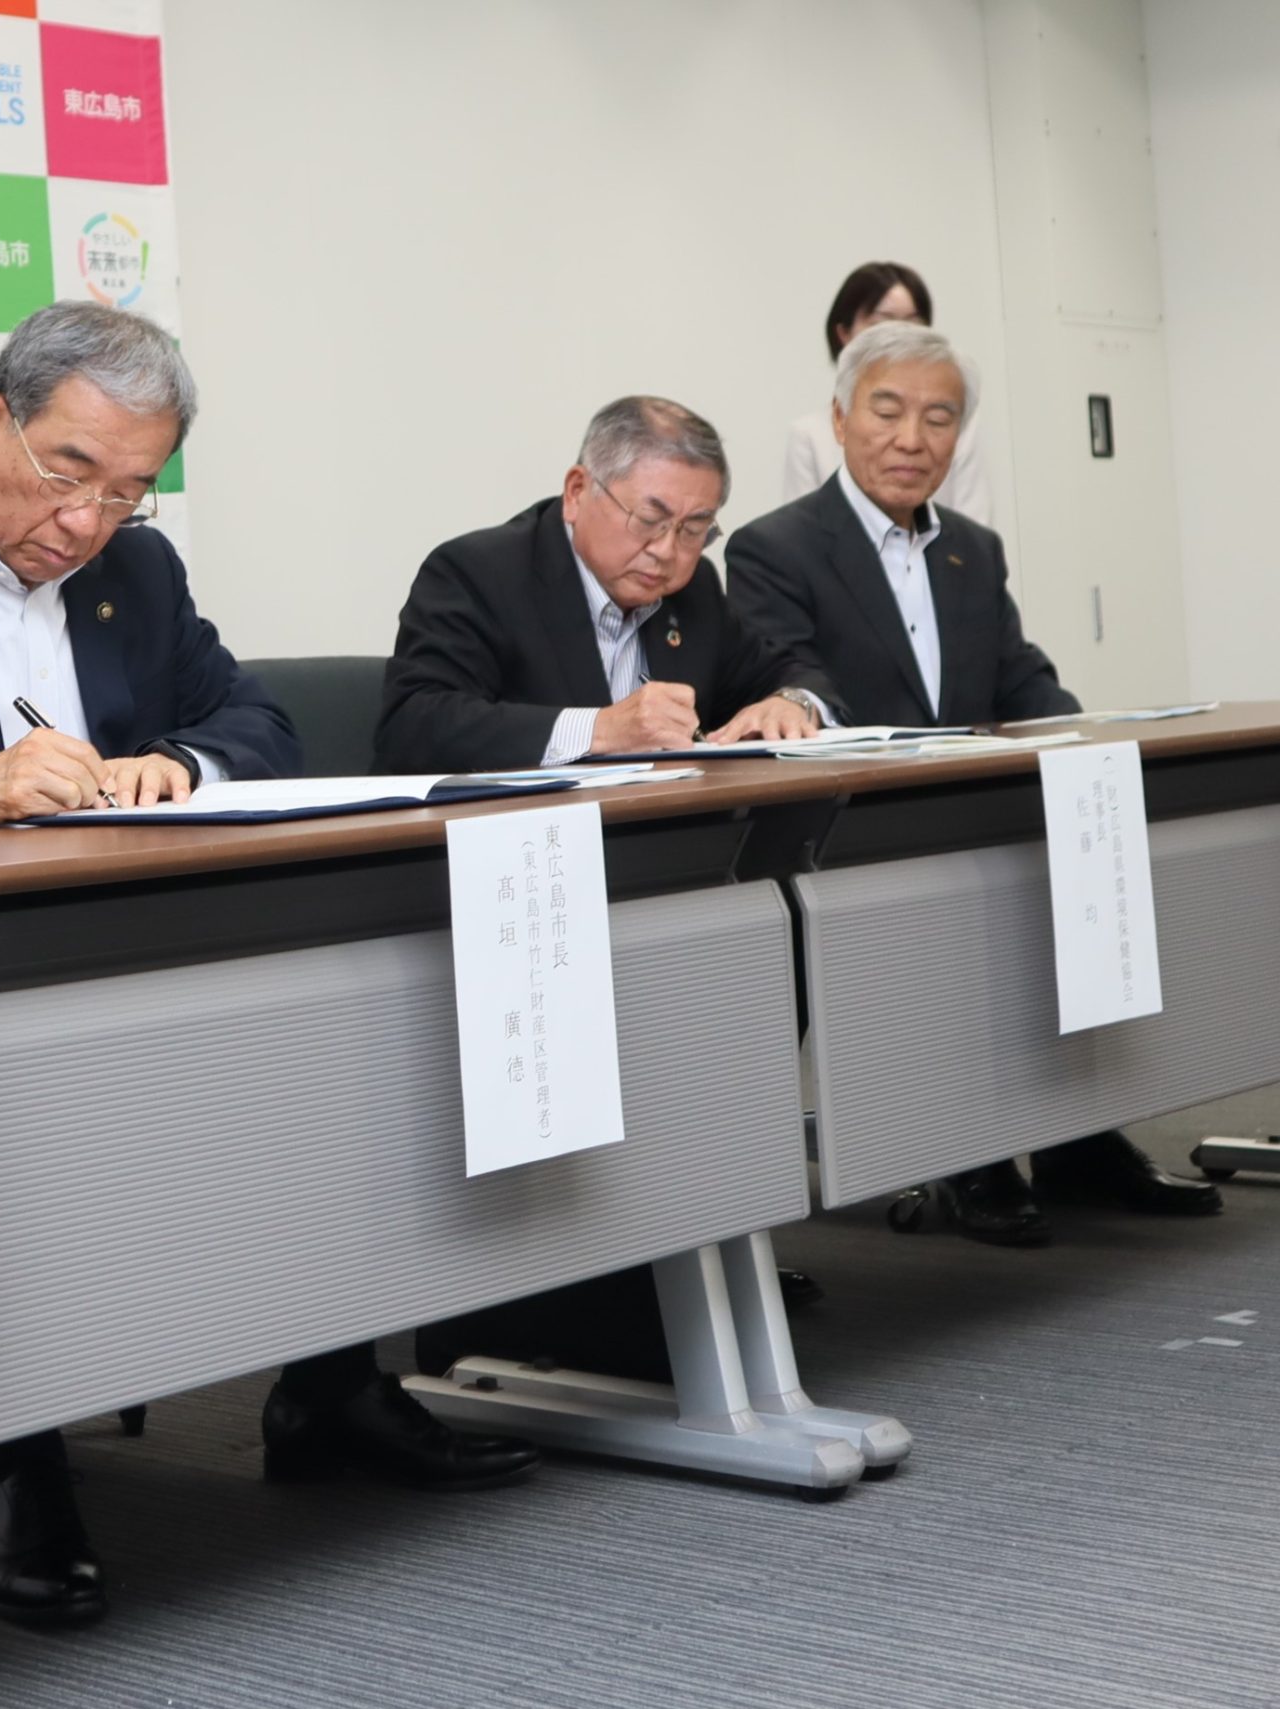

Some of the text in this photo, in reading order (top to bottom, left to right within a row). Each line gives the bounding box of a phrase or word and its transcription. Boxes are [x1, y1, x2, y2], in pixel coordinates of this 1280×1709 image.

[63, 89, 141, 121] 東広島市
[543, 824, 569, 969] 東広島市長
